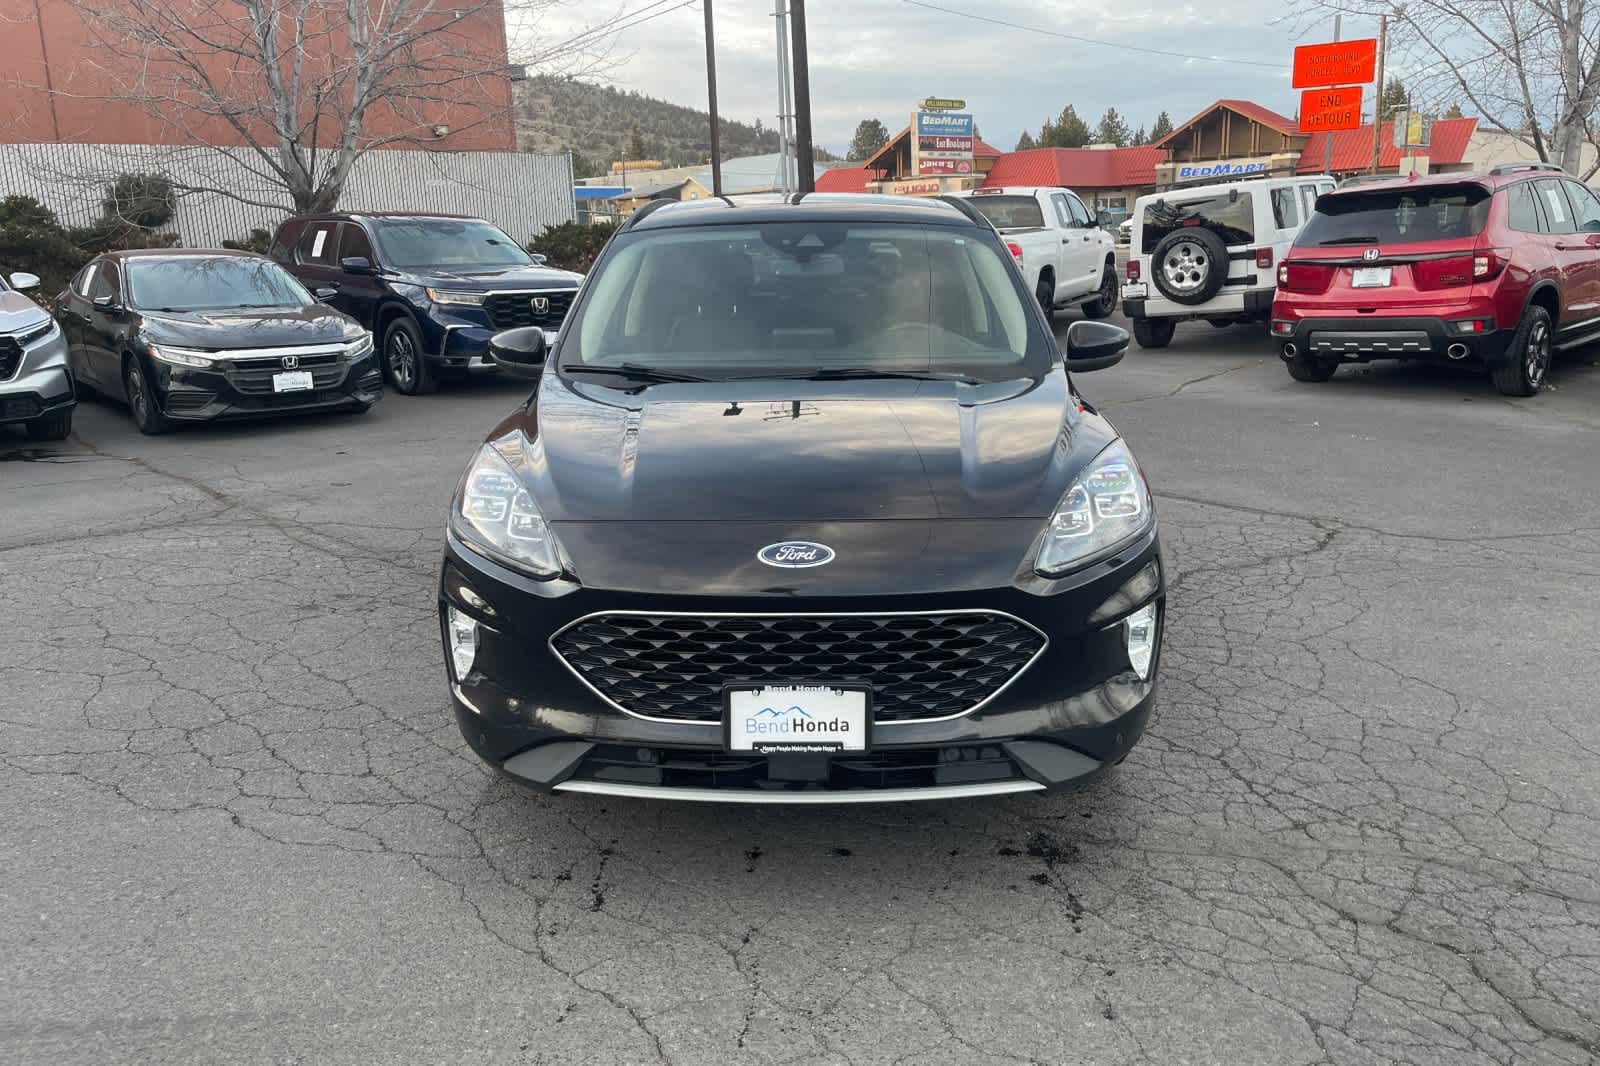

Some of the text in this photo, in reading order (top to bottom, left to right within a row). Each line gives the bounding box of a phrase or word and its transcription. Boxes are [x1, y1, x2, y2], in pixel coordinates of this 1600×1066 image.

[1320, 94, 1342, 107] END
[1307, 111, 1352, 126] DETOUR
[775, 545, 817, 561] Ford
